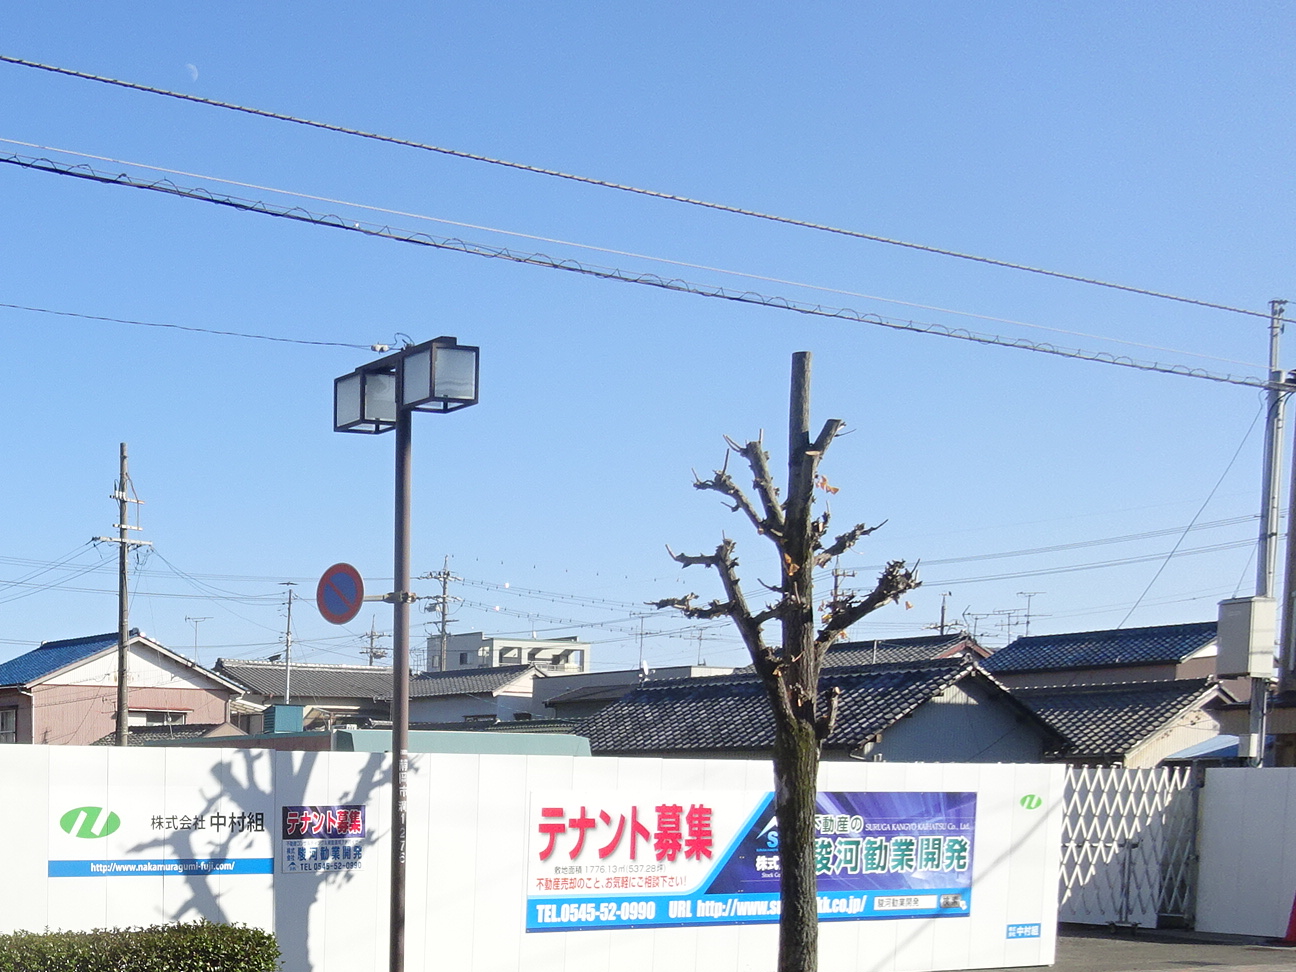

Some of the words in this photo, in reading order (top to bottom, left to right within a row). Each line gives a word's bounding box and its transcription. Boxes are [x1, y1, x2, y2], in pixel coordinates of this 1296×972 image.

[286, 810, 362, 835] テナント募集
[865, 823, 891, 832] SURUGA
[538, 804, 713, 862] テナント募集
[90, 861, 235, 873] http://www.nakamuragumi-fuji.com/
[300, 863, 312, 872] TEL
[755, 855, 781, 871] 株式
[536, 901, 656, 923] TEL.0545-52-0990
[668, 901, 692, 919] URL
